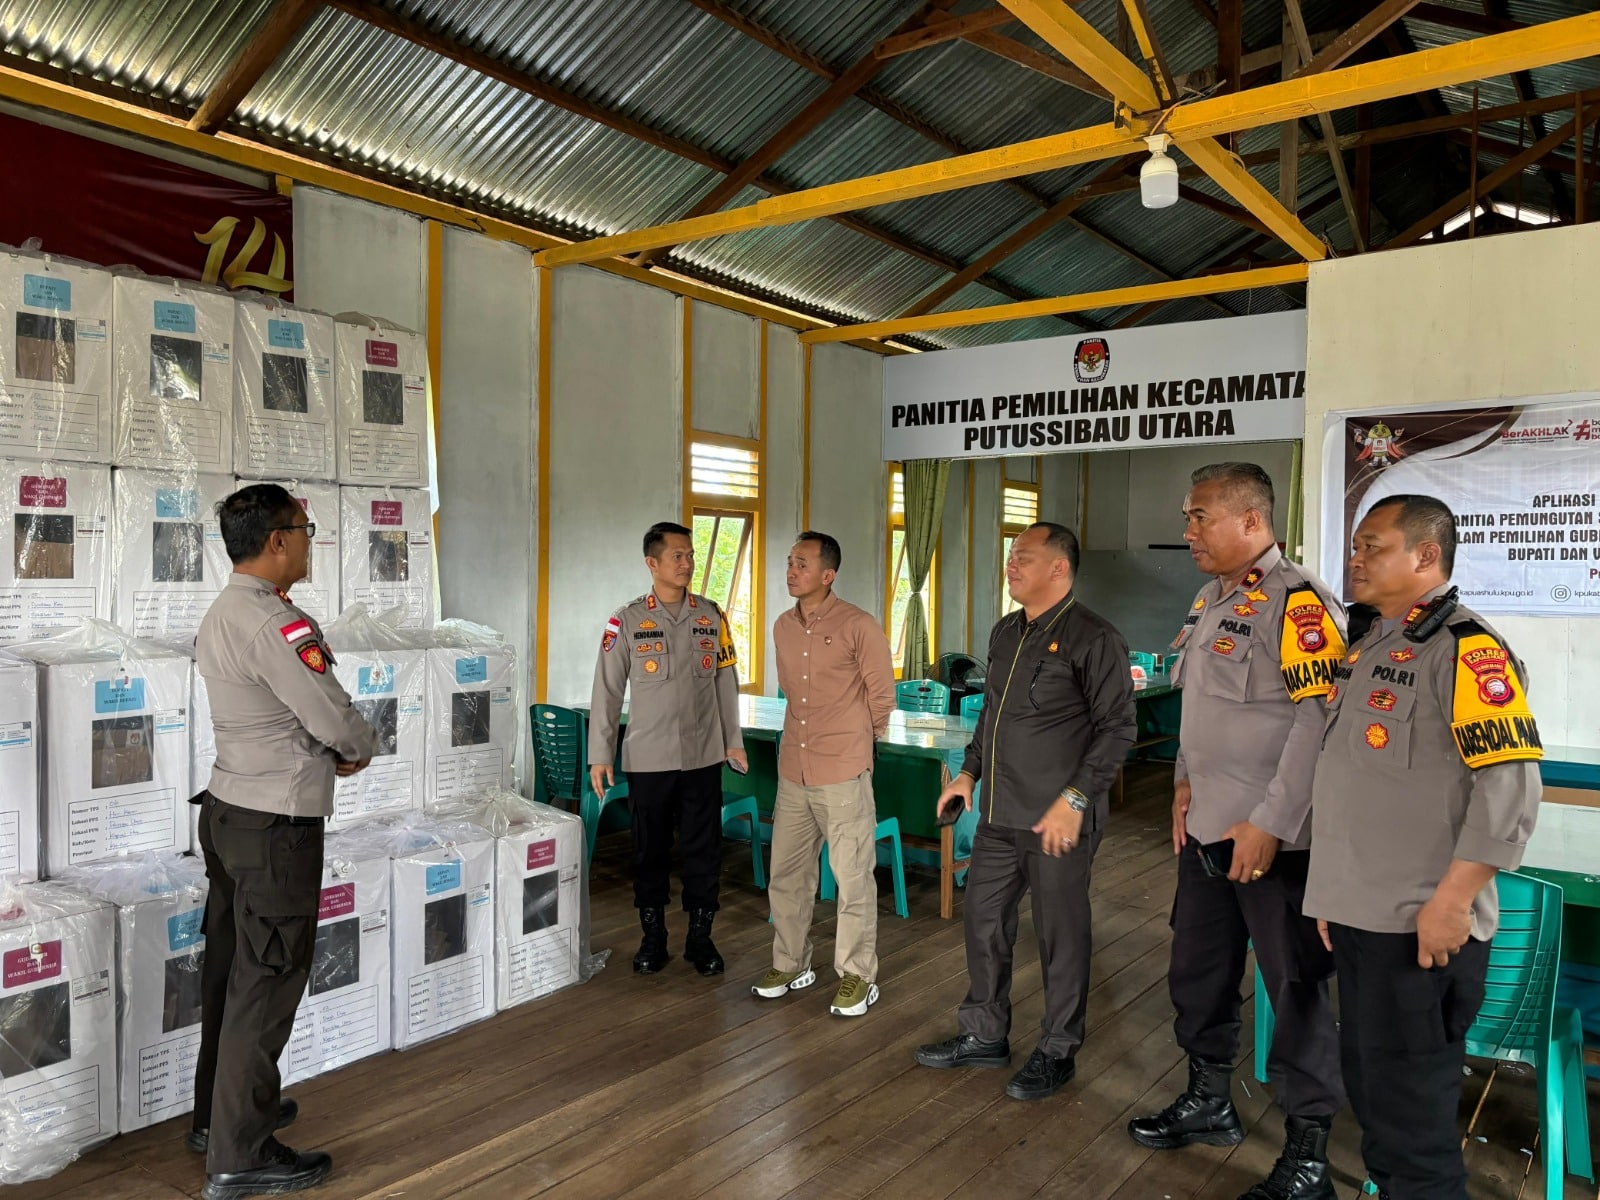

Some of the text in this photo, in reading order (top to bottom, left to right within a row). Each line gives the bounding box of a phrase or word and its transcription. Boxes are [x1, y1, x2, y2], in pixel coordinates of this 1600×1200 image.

[891, 397, 986, 428] PANITIA
[992, 383, 1139, 421] PEMILIHAN
[963, 409, 1236, 451] PUTUSSIBAU UTARA
[1502, 427, 1569, 438] BerAKHLAK
[1532, 494, 1596, 508] APLIKASI
[1499, 511, 1593, 526] PEMUNGUTAN
[1489, 530, 1565, 544] PEMILIHAN
[1569, 529, 1600, 543] GUB
[1507, 548, 1554, 561] BUPATI
[1560, 548, 1587, 561] DAN
[692, 627, 719, 637] POLRI
[1217, 619, 1251, 638] POLRI
[1371, 665, 1415, 688] POLRI
